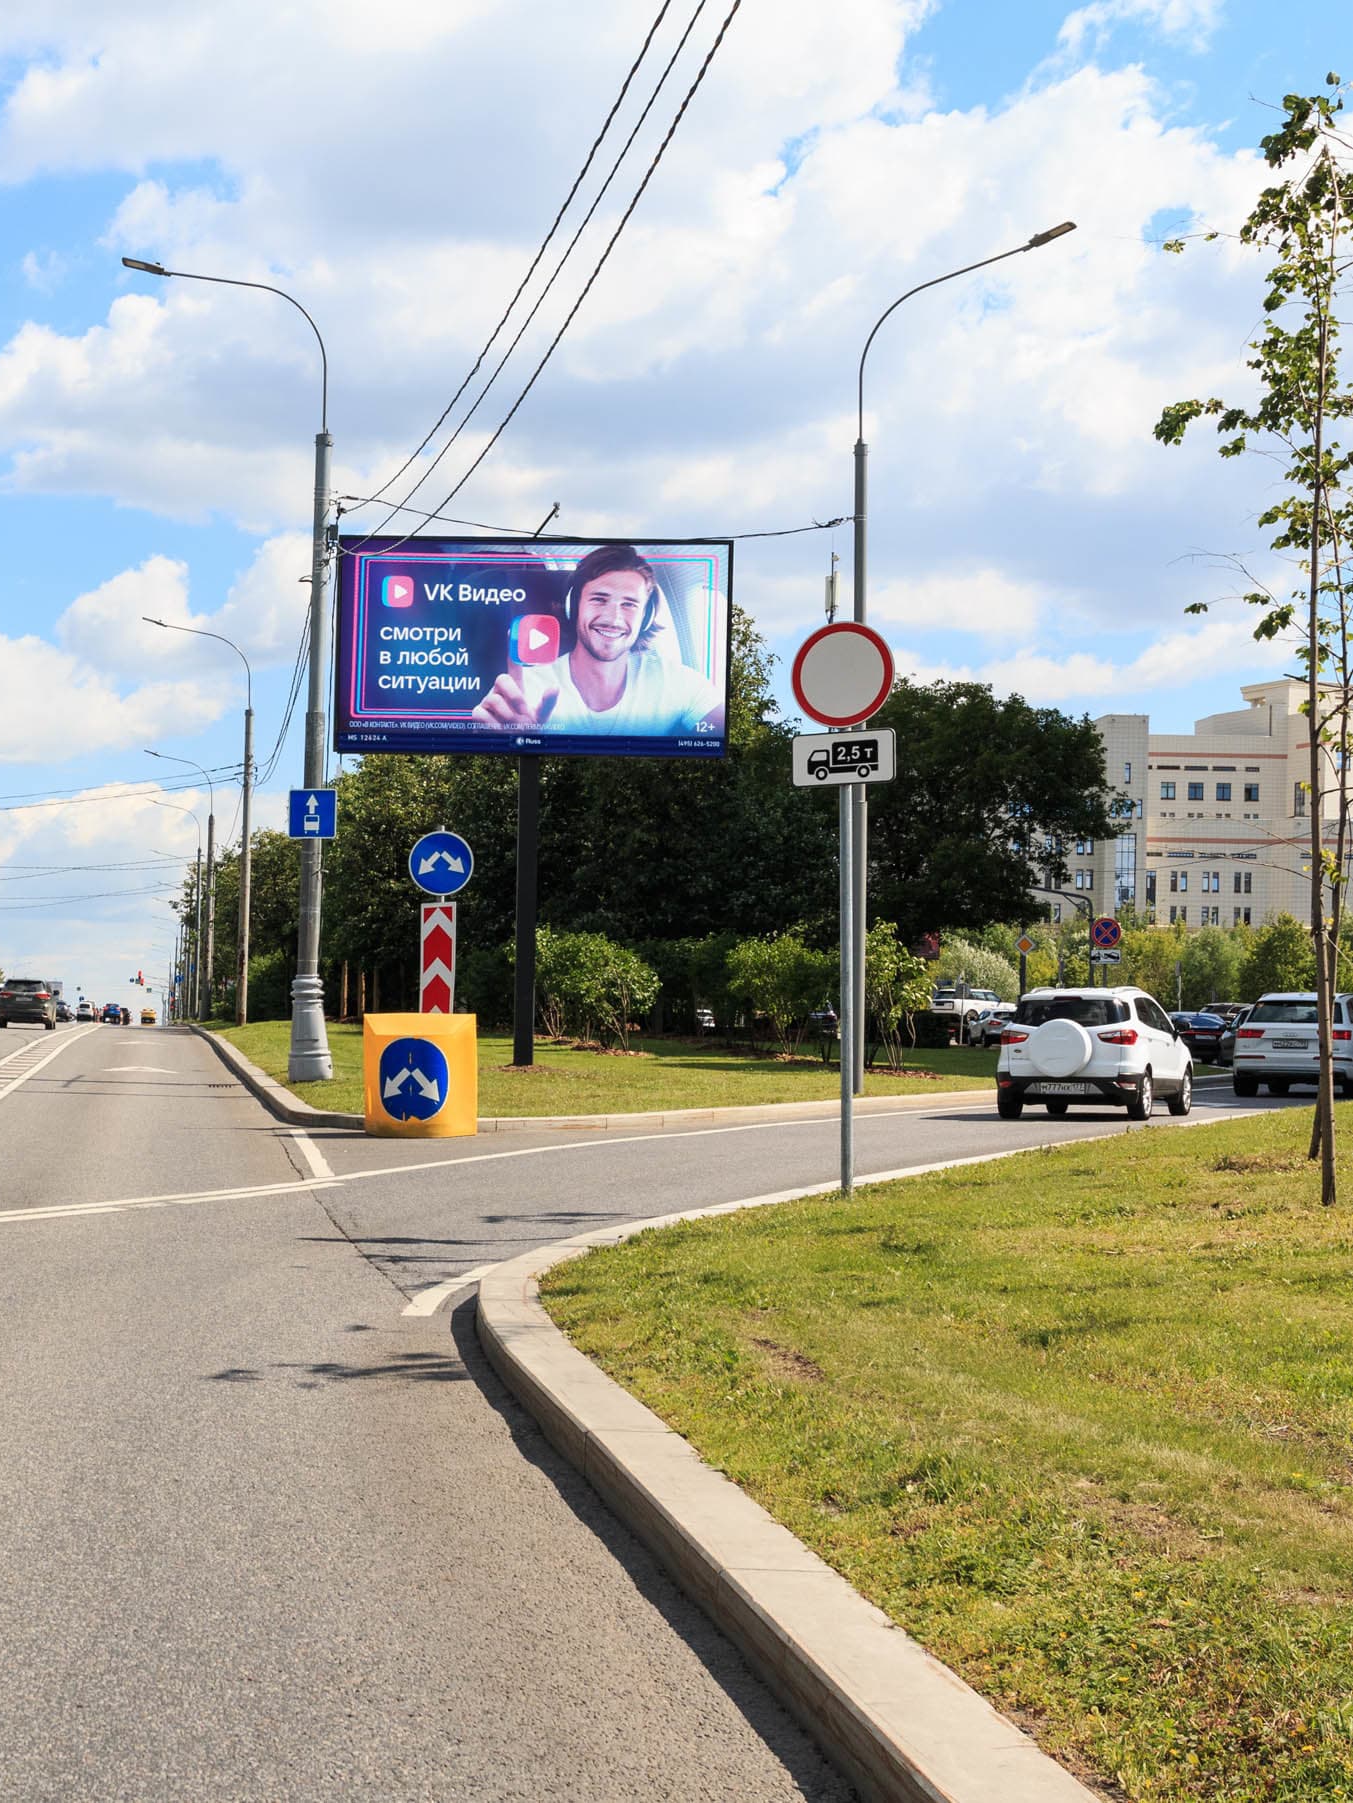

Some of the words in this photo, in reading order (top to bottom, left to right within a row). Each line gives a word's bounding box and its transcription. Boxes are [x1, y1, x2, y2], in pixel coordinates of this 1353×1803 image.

[424, 583, 454, 601] VK
[458, 584, 526, 605] Видео
[380, 626, 462, 646] смотри
[379, 651, 392, 665] в
[397, 648, 469, 666] любой
[378, 675, 481, 694] ситуации
[695, 721, 716, 733] 12+
[836, 745, 861, 763] 2,5
